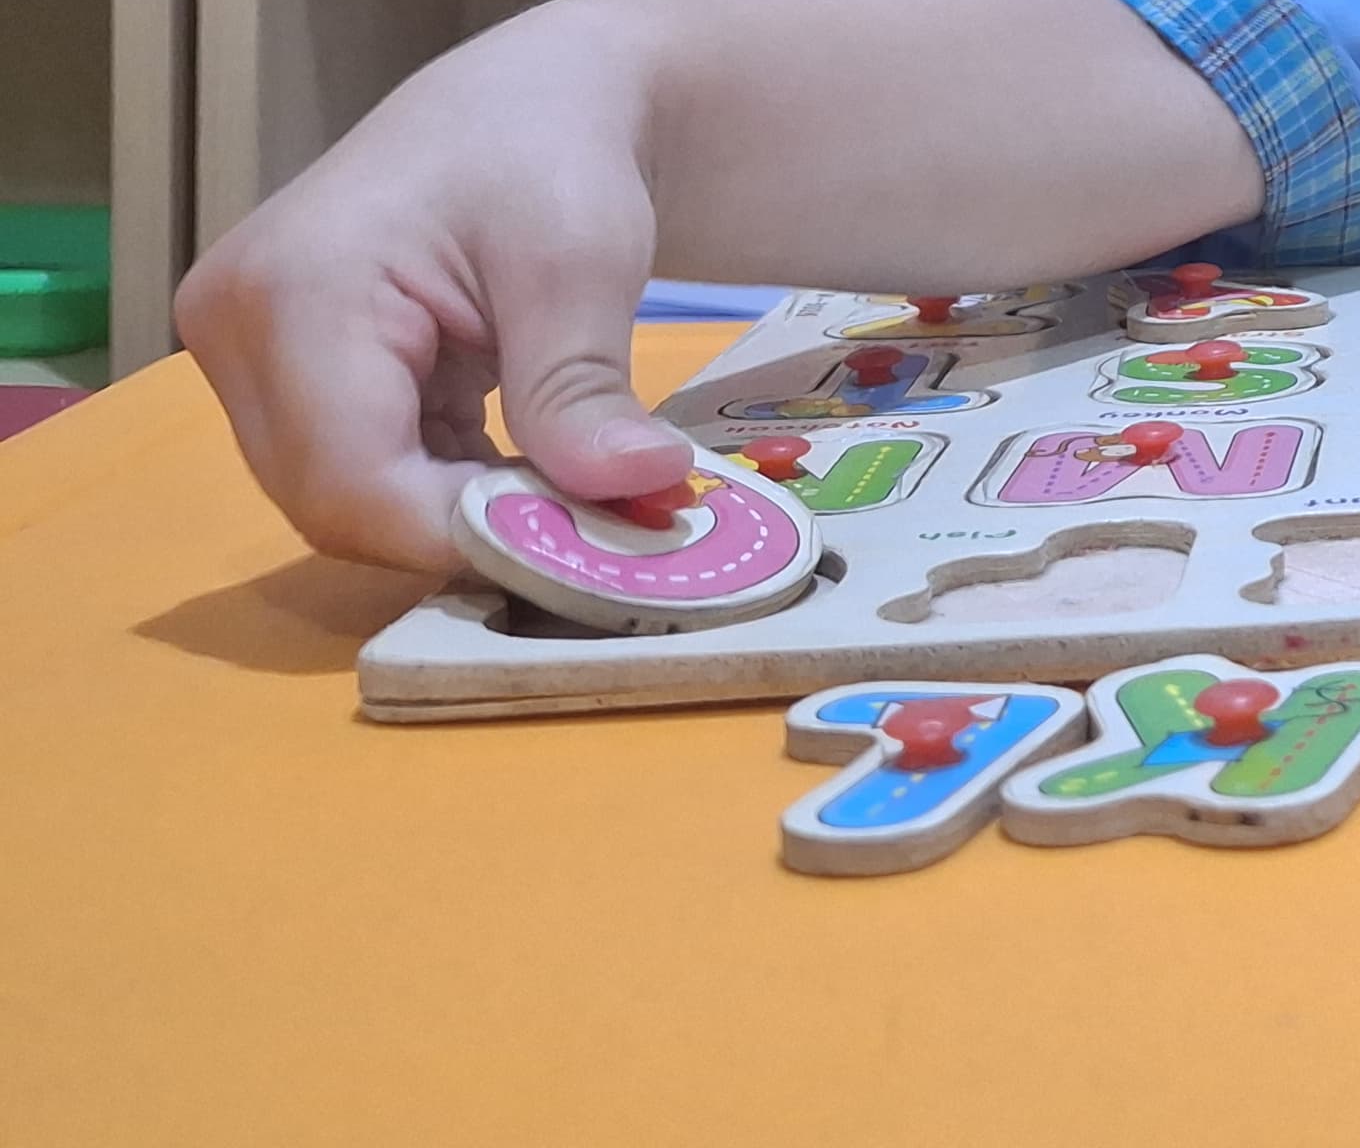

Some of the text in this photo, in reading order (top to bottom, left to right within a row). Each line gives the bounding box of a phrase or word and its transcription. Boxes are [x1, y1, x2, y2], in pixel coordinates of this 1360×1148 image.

[1097, 408, 1250, 420] Monkey
[724, 420, 920, 434] Notebook
[916, 528, 1018, 541] Fish
